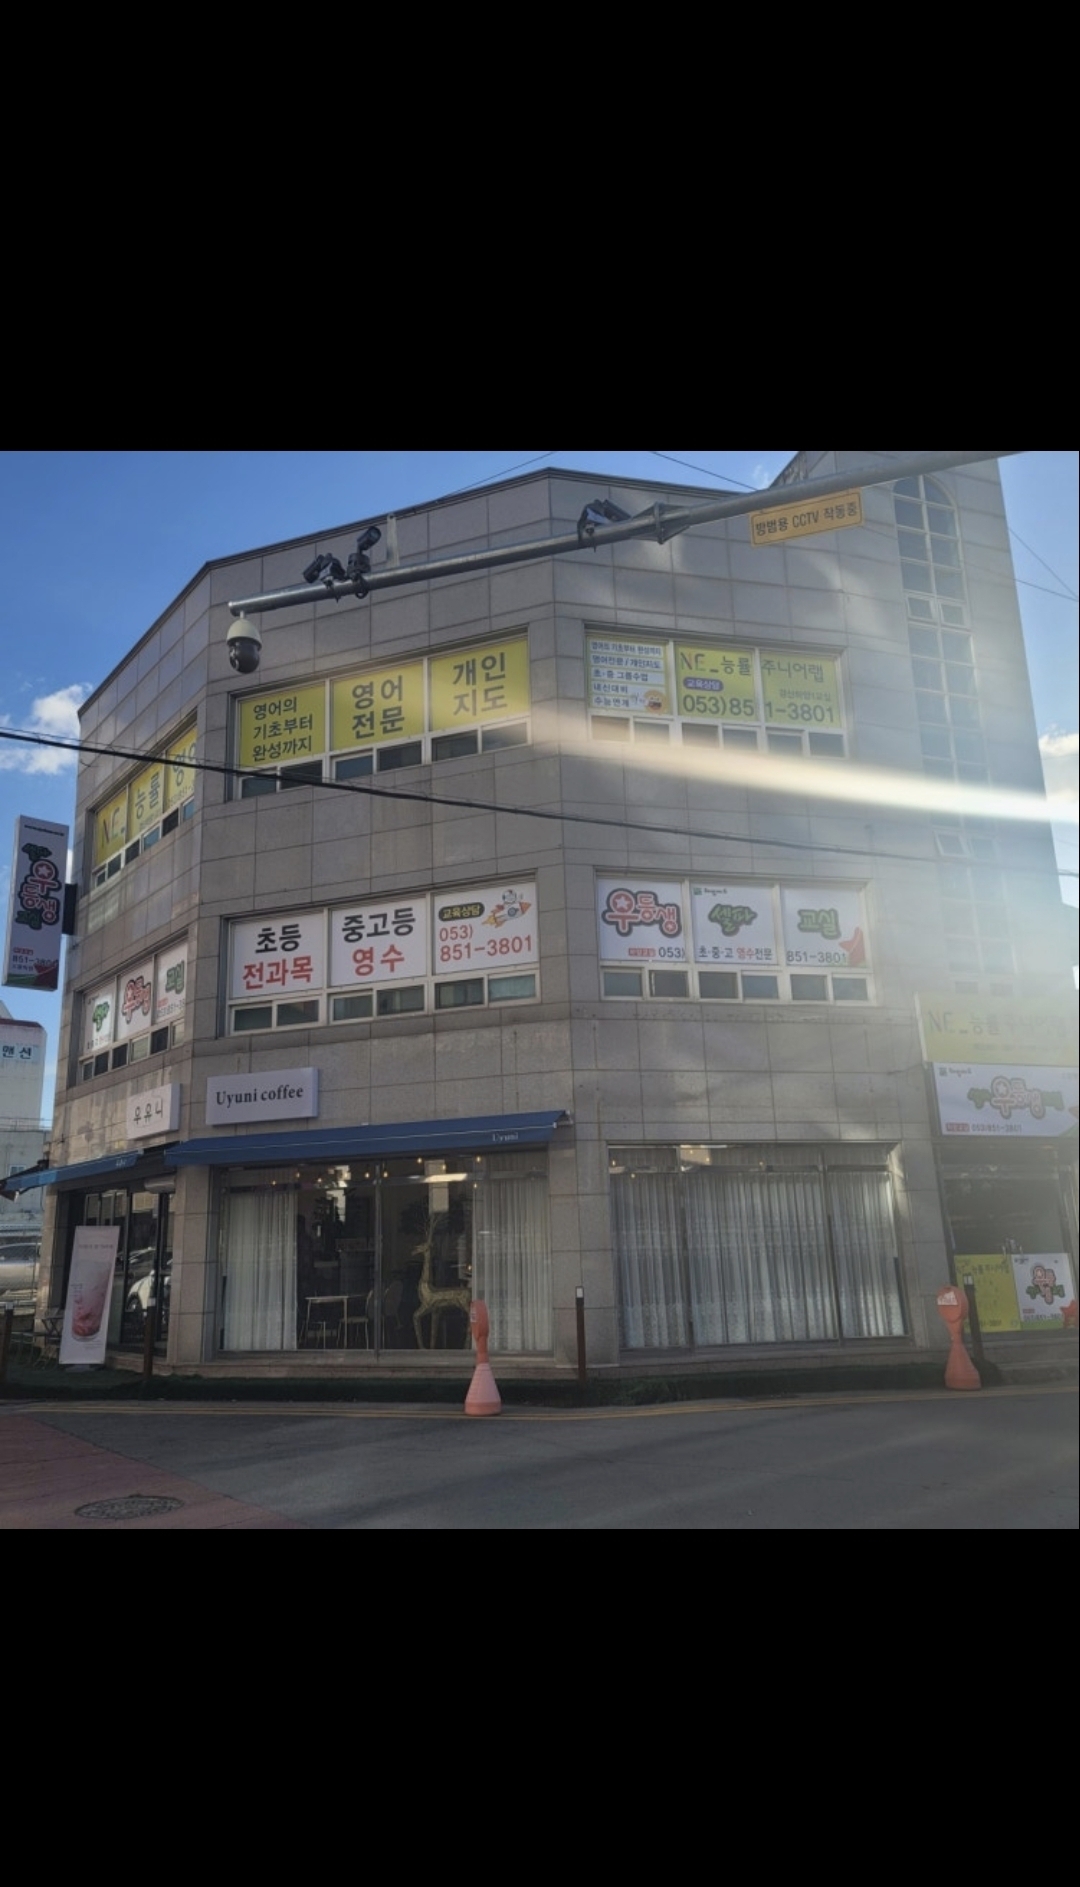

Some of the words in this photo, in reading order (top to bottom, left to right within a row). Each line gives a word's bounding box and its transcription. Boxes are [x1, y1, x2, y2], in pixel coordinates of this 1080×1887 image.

[755, 517, 788, 537] 방범용
[792, 510, 820, 528] CCTV
[823, 502, 857, 520] 작동중
[452, 652, 506, 686] 개인
[616, 671, 649, 682] 그룹수업
[351, 675, 404, 711] 영어
[593, 682, 628, 694] 내신대비
[686, 678, 722, 691] 교육상담
[252, 697, 297, 721] 영어의
[453, 684, 508, 717] 지도
[253, 714, 313, 740] 기초부터
[351, 706, 405, 740] 전문
[252, 735, 312, 762] 완성까지
[342, 907, 416, 944] 중고등
[441, 904, 483, 920] 교육상담
[602, 888, 682, 938] 우등생
[708, 903, 757, 937] 셀파
[797, 908, 842, 940] 교실
[255, 923, 302, 955] 초등
[439, 924, 474, 942] 053)
[352, 944, 405, 976] 영수
[439, 934, 533, 962] 851-3801
[242, 955, 314, 991] 전과목
[215, 1088, 258, 1108] Uyuni
[260, 1084, 304, 1102] coffee
[133, 1098, 164, 1125] 우유니
